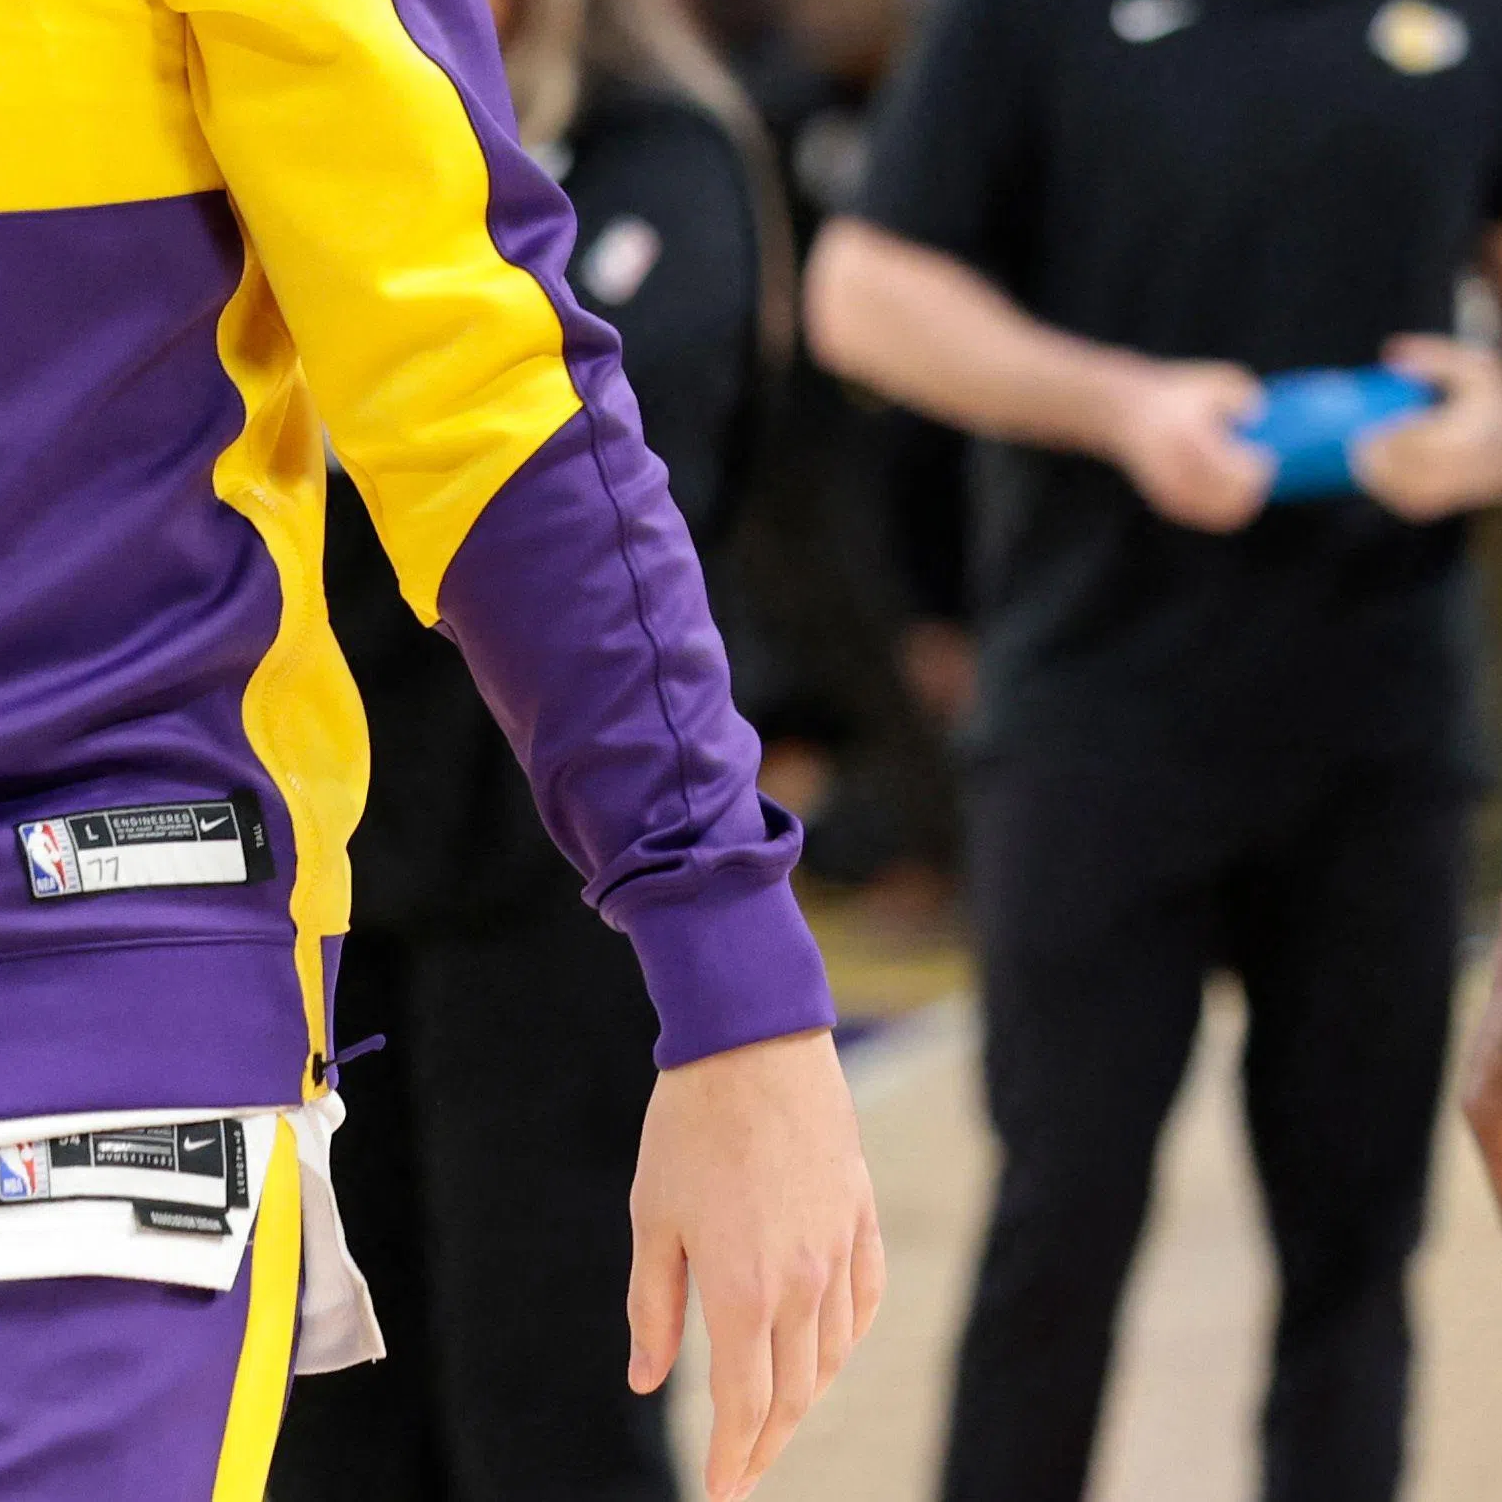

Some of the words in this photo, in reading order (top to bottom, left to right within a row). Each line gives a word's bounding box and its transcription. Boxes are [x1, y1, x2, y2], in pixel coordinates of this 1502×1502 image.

[112, 812, 190, 829] ENGINEERED
[84, 823, 99, 842] L
[252, 822, 265, 849] TALL
[87, 856, 120, 883] 77
